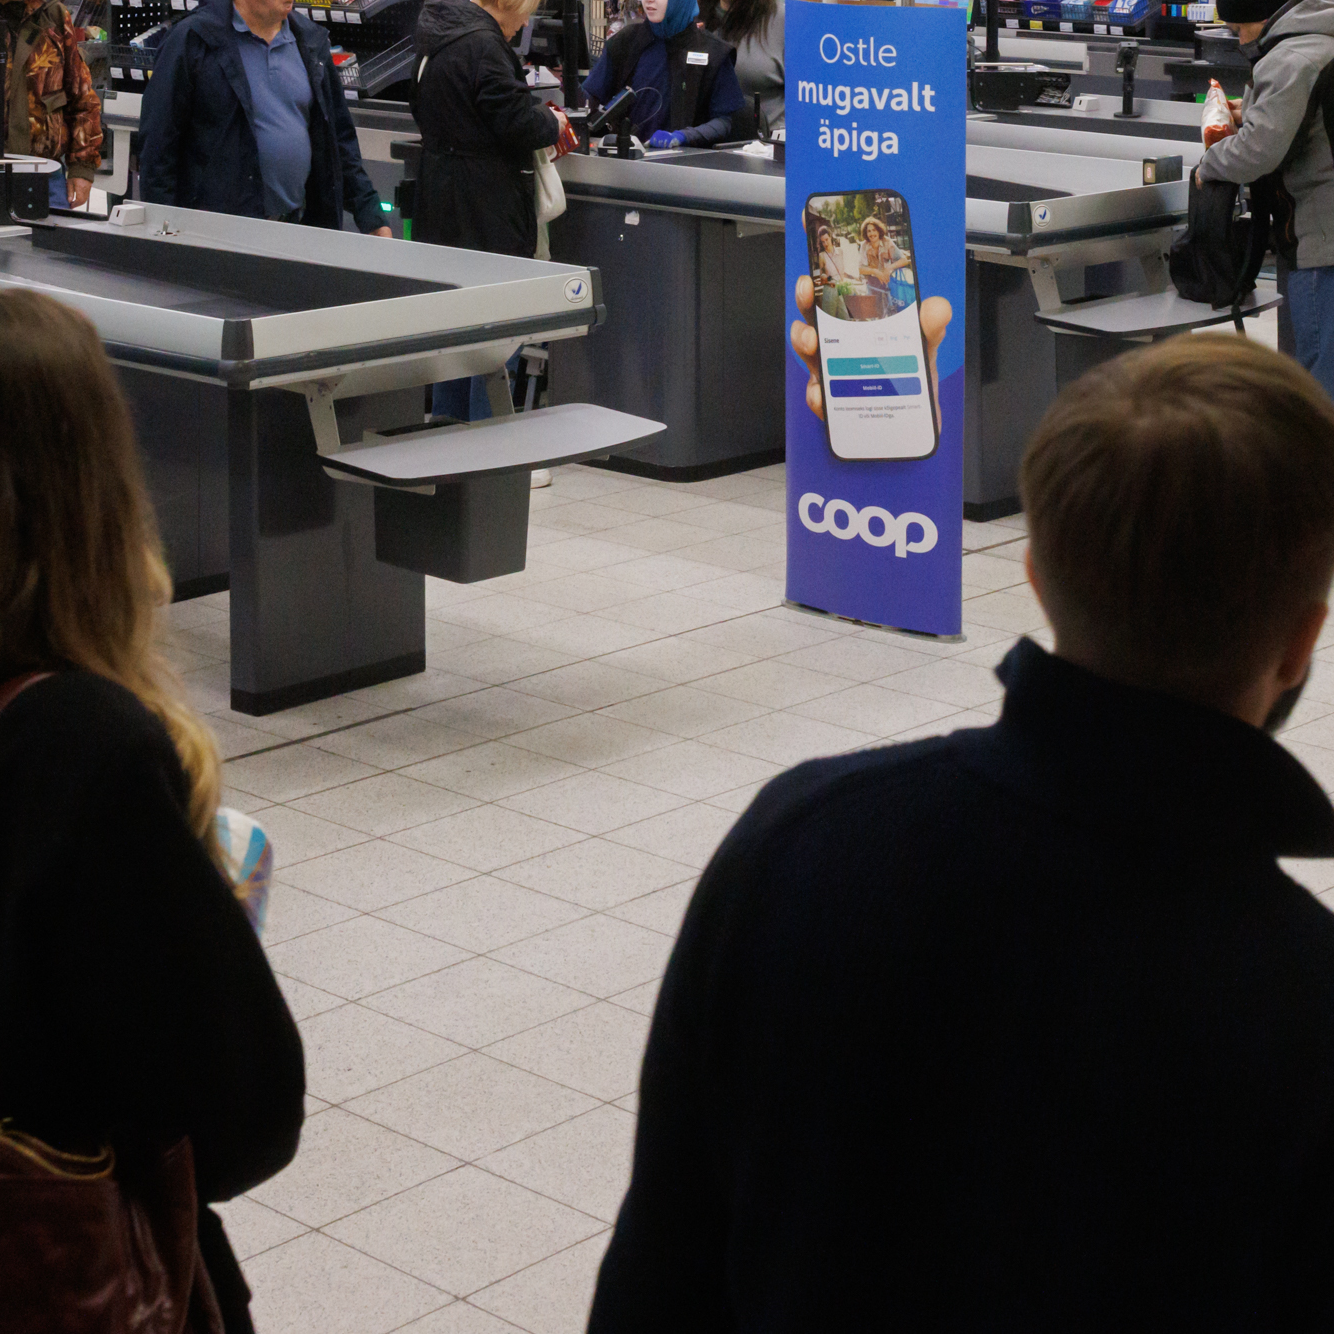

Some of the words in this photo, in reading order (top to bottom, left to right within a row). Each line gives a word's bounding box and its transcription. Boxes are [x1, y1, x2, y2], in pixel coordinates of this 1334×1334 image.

[819, 33, 897, 67] Ostle
[798, 81, 936, 116] mugavalt
[818, 119, 899, 161] äpiga
[798, 492, 938, 558] coop
